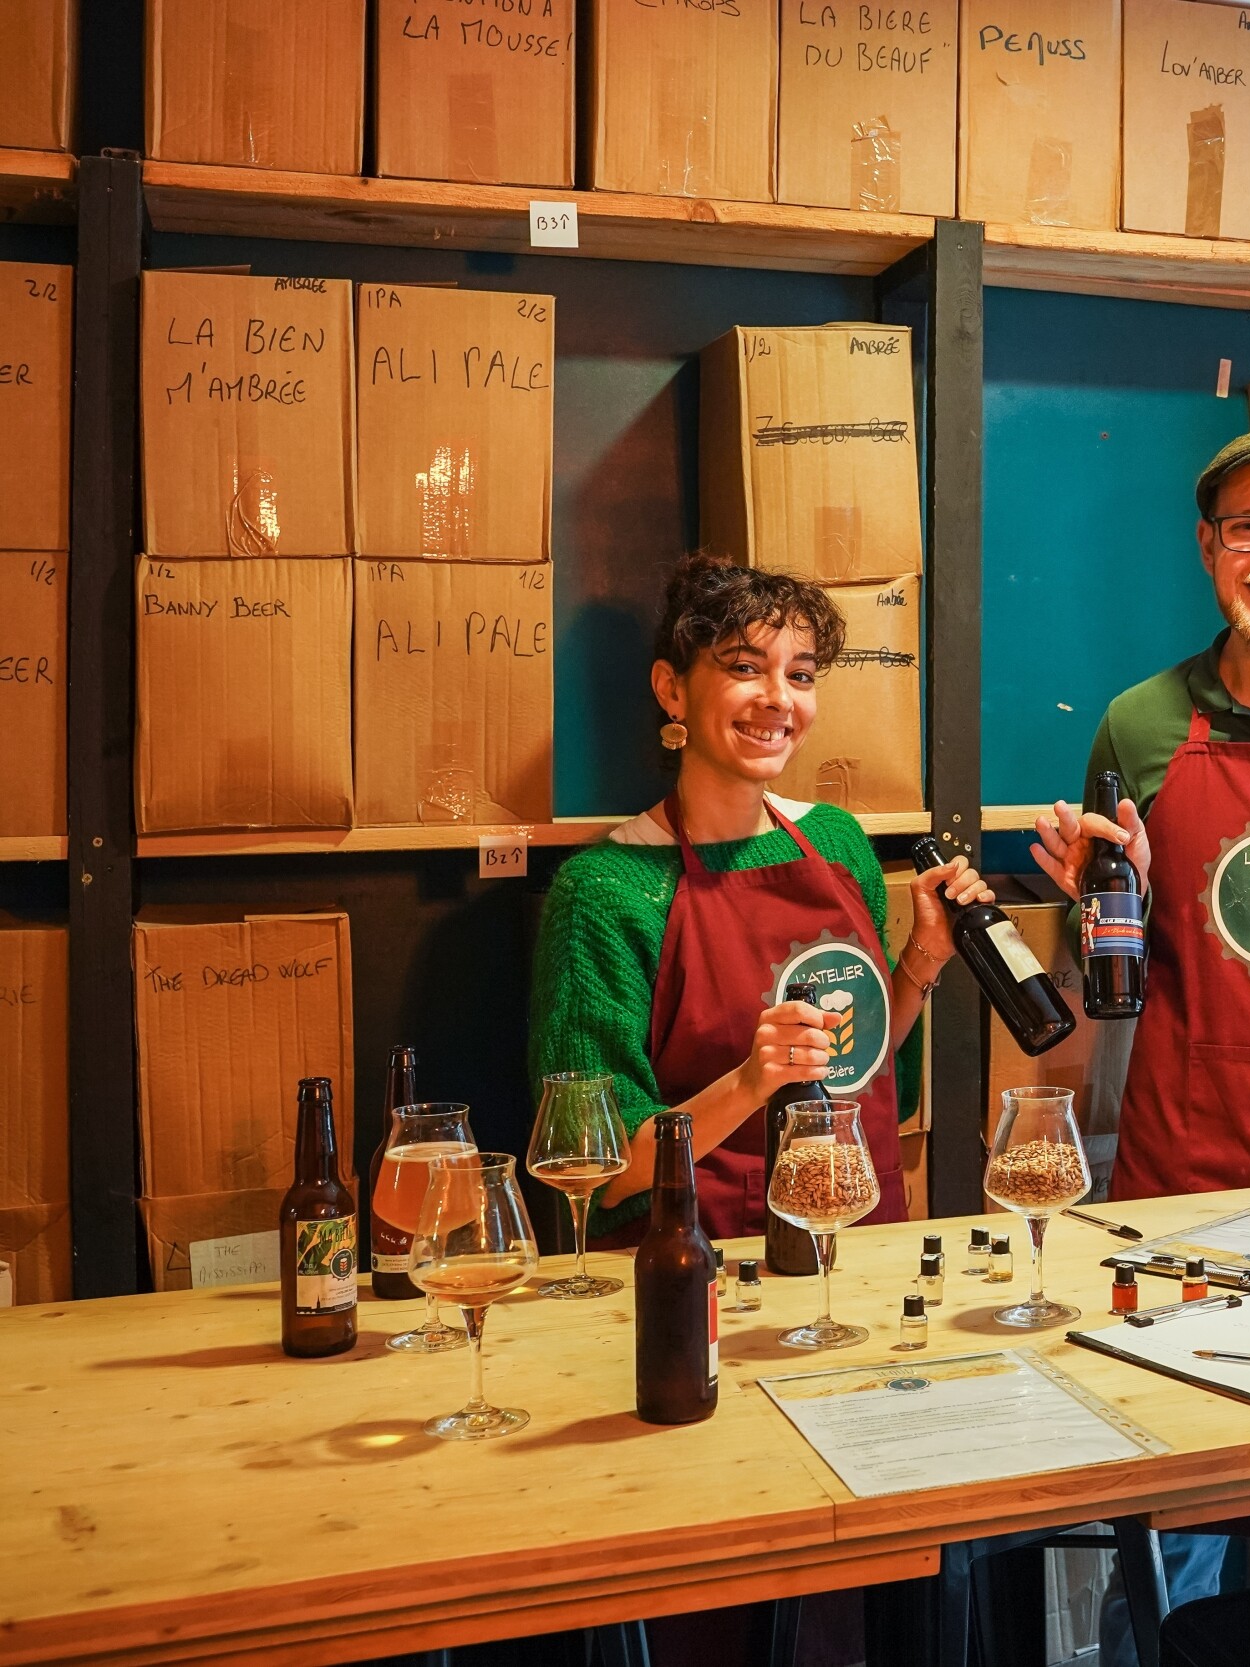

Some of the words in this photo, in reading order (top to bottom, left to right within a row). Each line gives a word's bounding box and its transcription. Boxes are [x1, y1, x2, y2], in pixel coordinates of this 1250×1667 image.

[403, 15, 440, 40] LA
[800, 1, 836, 27] LA
[858, 5, 932, 34] BIERE
[805, 44, 843, 67] DU
[25, 279, 57, 301] 2/2
[368, 287, 402, 309] IPA
[517, 299, 547, 323] 2/2
[168, 317, 214, 348] LA
[246, 318, 325, 354] BIEN
[743, 335, 771, 363] 1/2
[372, 347, 437, 385] ALI
[464, 346, 550, 392] PALE
[31, 560, 56, 586] 1/2
[150, 563, 176, 579] 1/2
[370, 561, 405, 583] IPA
[519, 570, 545, 590] 1/2
[144, 594, 218, 618] BANNY
[230, 596, 291, 619] BEER
[377, 619, 442, 662] ALI
[464, 611, 547, 657] PALE
[144, 965, 183, 993] THE
[203, 963, 270, 991] DREAD
[277, 957, 333, 979] WOLF
[828, 1065, 856, 1081] Bière
[214, 1244, 241, 1259] THE
